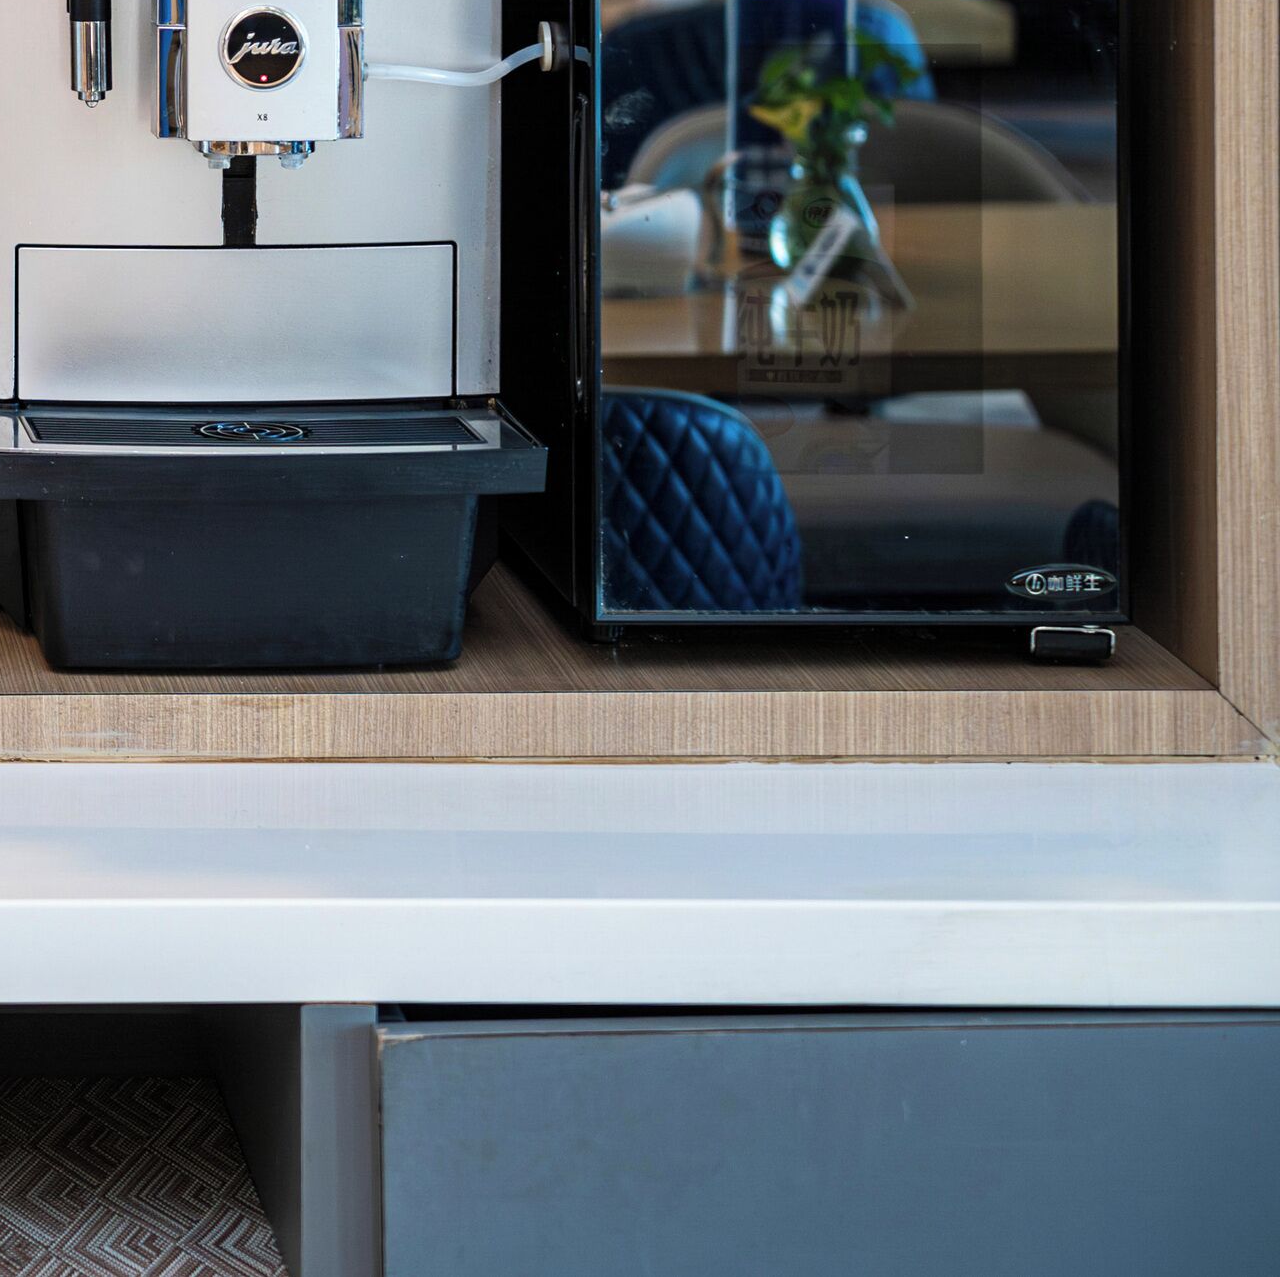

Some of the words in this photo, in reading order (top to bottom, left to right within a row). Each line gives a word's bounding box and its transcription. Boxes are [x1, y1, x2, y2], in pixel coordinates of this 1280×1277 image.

[229, 32, 298, 65] jura
[1047, 573, 1105, 592] 咖鲜生
